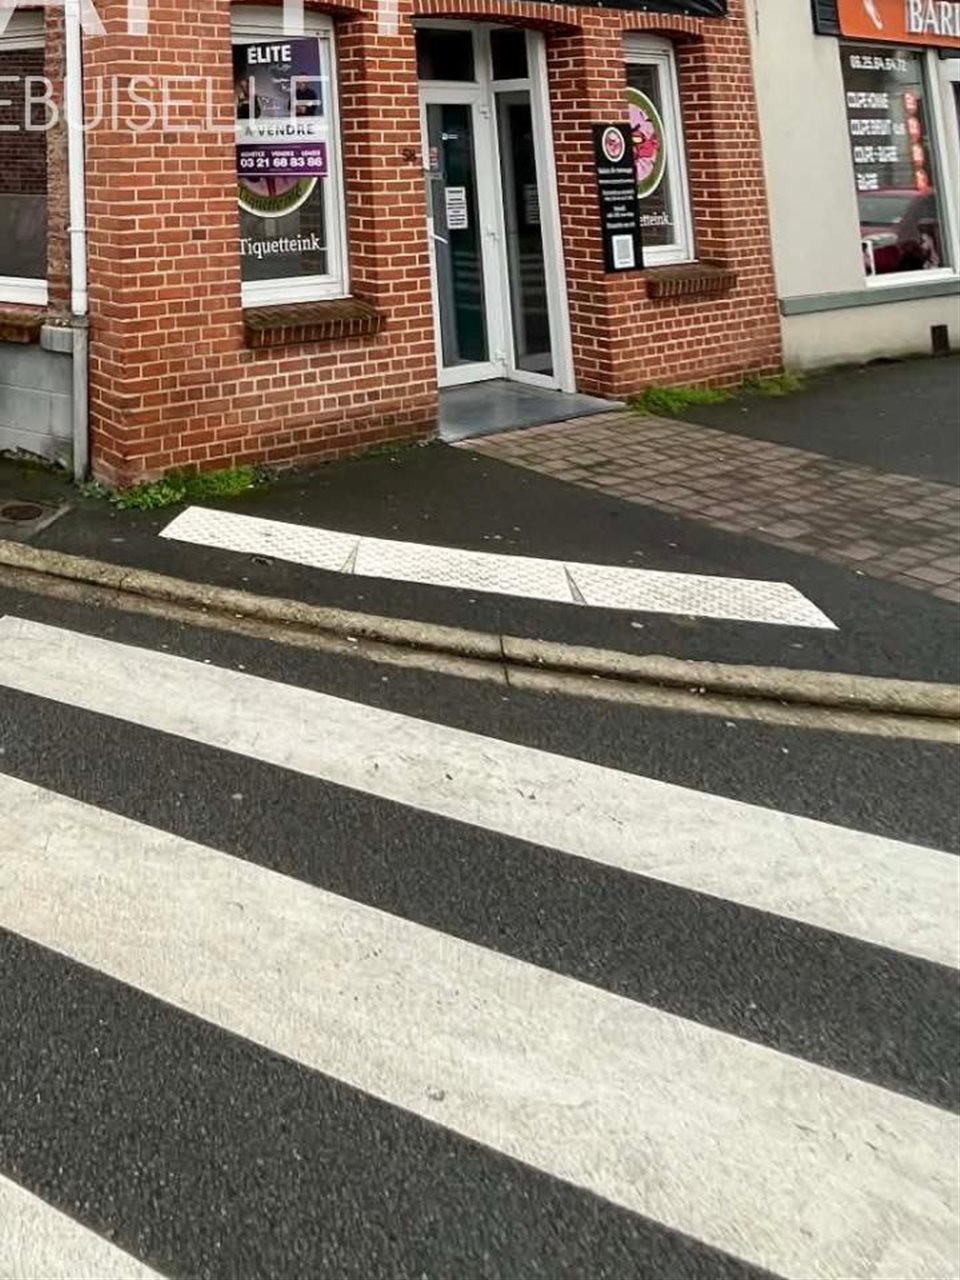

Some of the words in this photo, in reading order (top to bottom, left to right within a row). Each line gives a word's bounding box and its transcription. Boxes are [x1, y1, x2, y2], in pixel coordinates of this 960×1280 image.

[258, 123, 316, 137] VENDRE
[240, 157, 254, 168] 03
[256, 157, 270, 168] 21
[272, 157, 288, 168] 68
[240, 233, 321, 259] Tiquetteink
